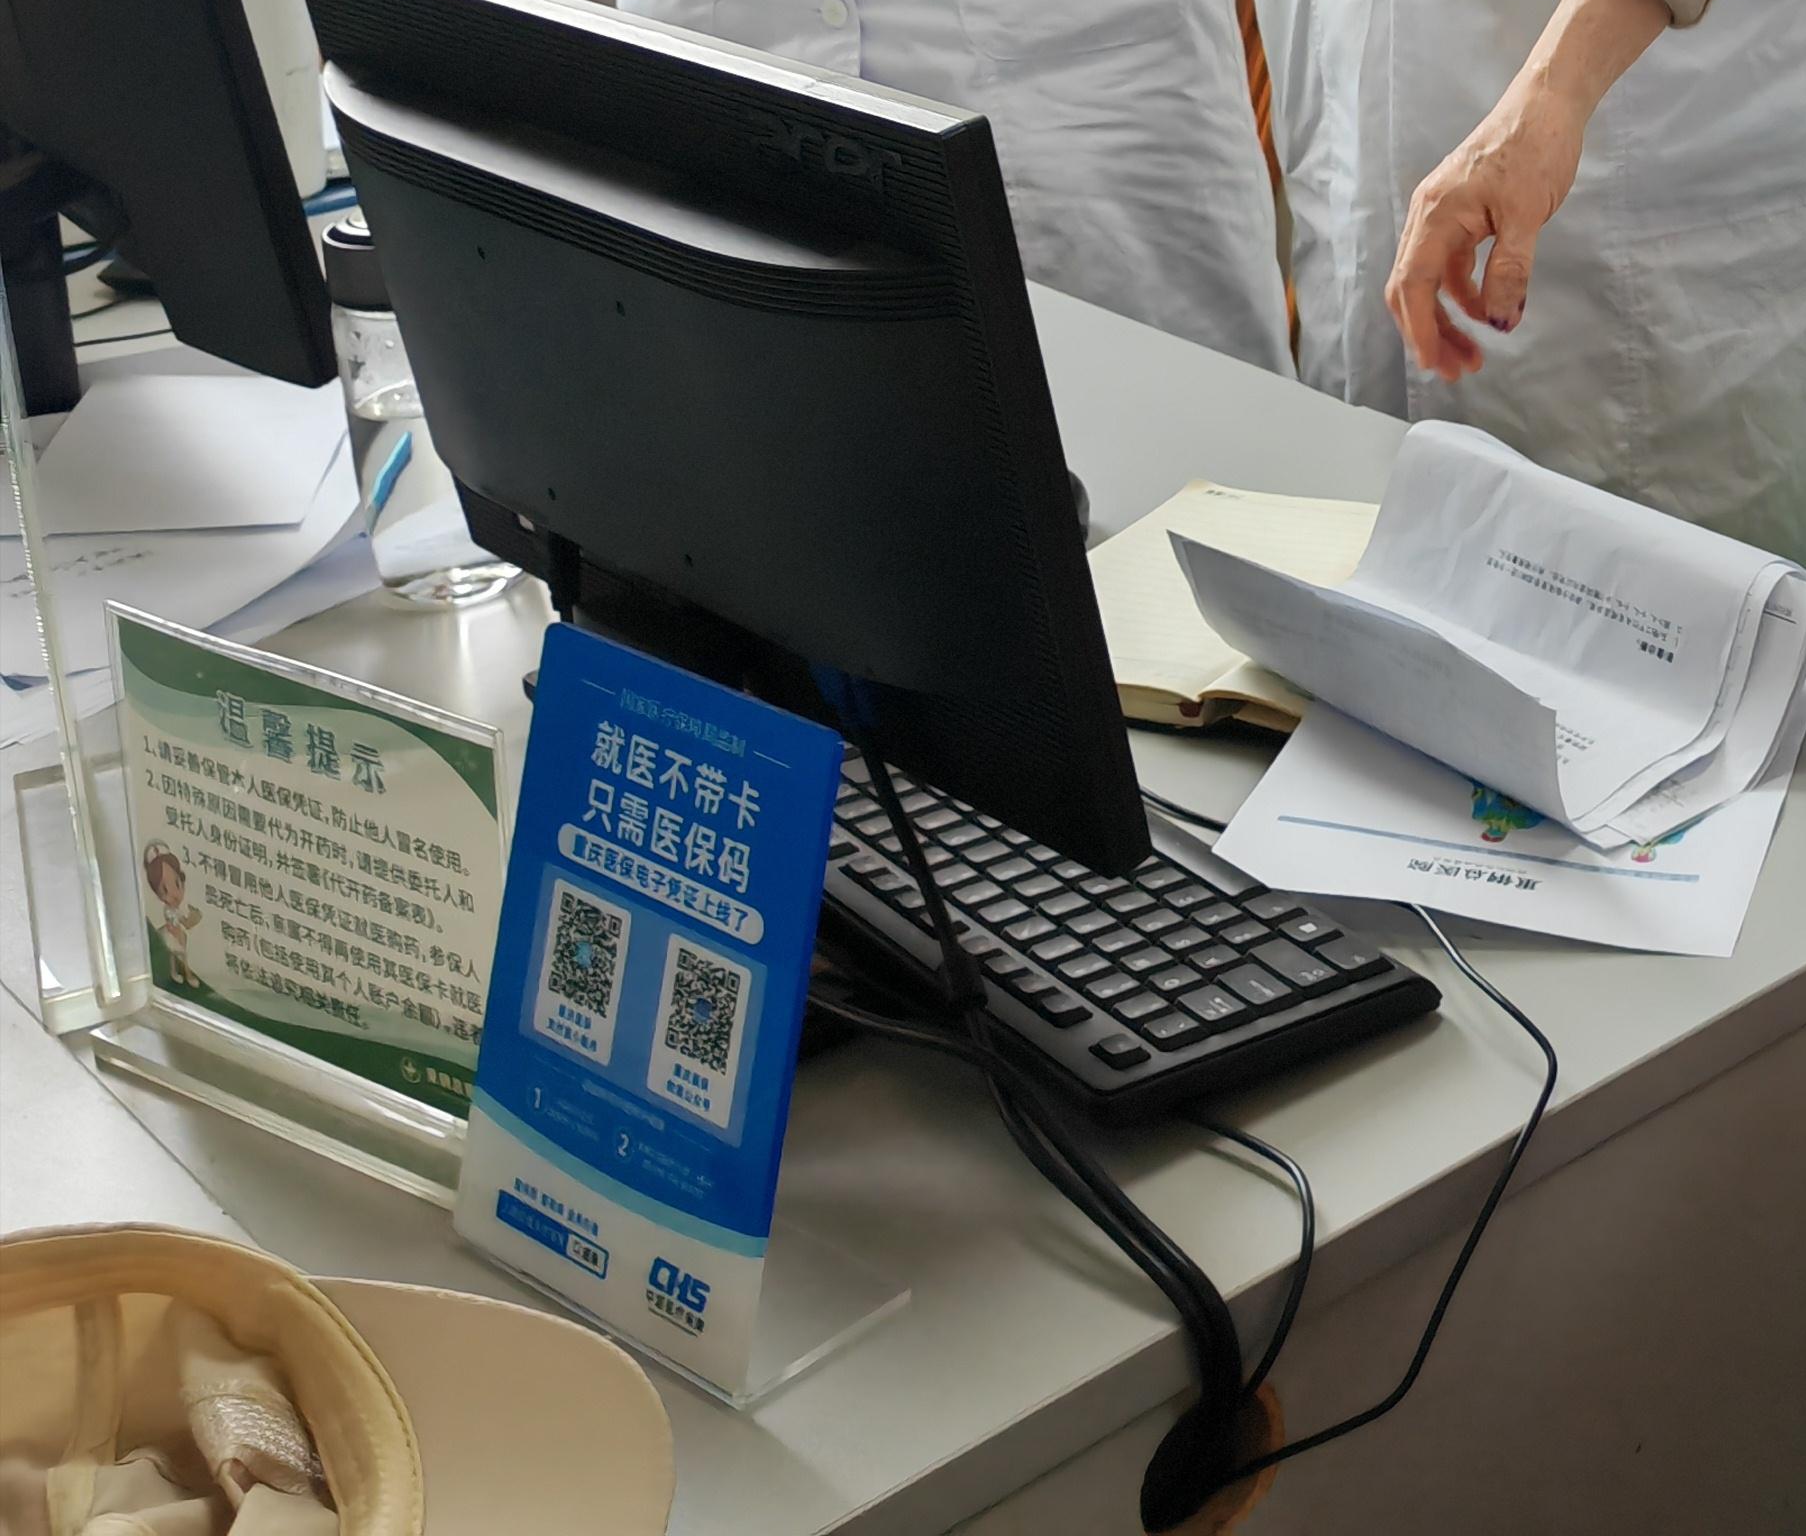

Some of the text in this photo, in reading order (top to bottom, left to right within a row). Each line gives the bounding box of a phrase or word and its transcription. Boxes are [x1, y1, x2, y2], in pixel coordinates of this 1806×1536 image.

[216, 690, 387, 795] 温馨提示
[591, 720, 760, 830] 就医不带卡
[583, 779, 750, 894] 只需医保码
